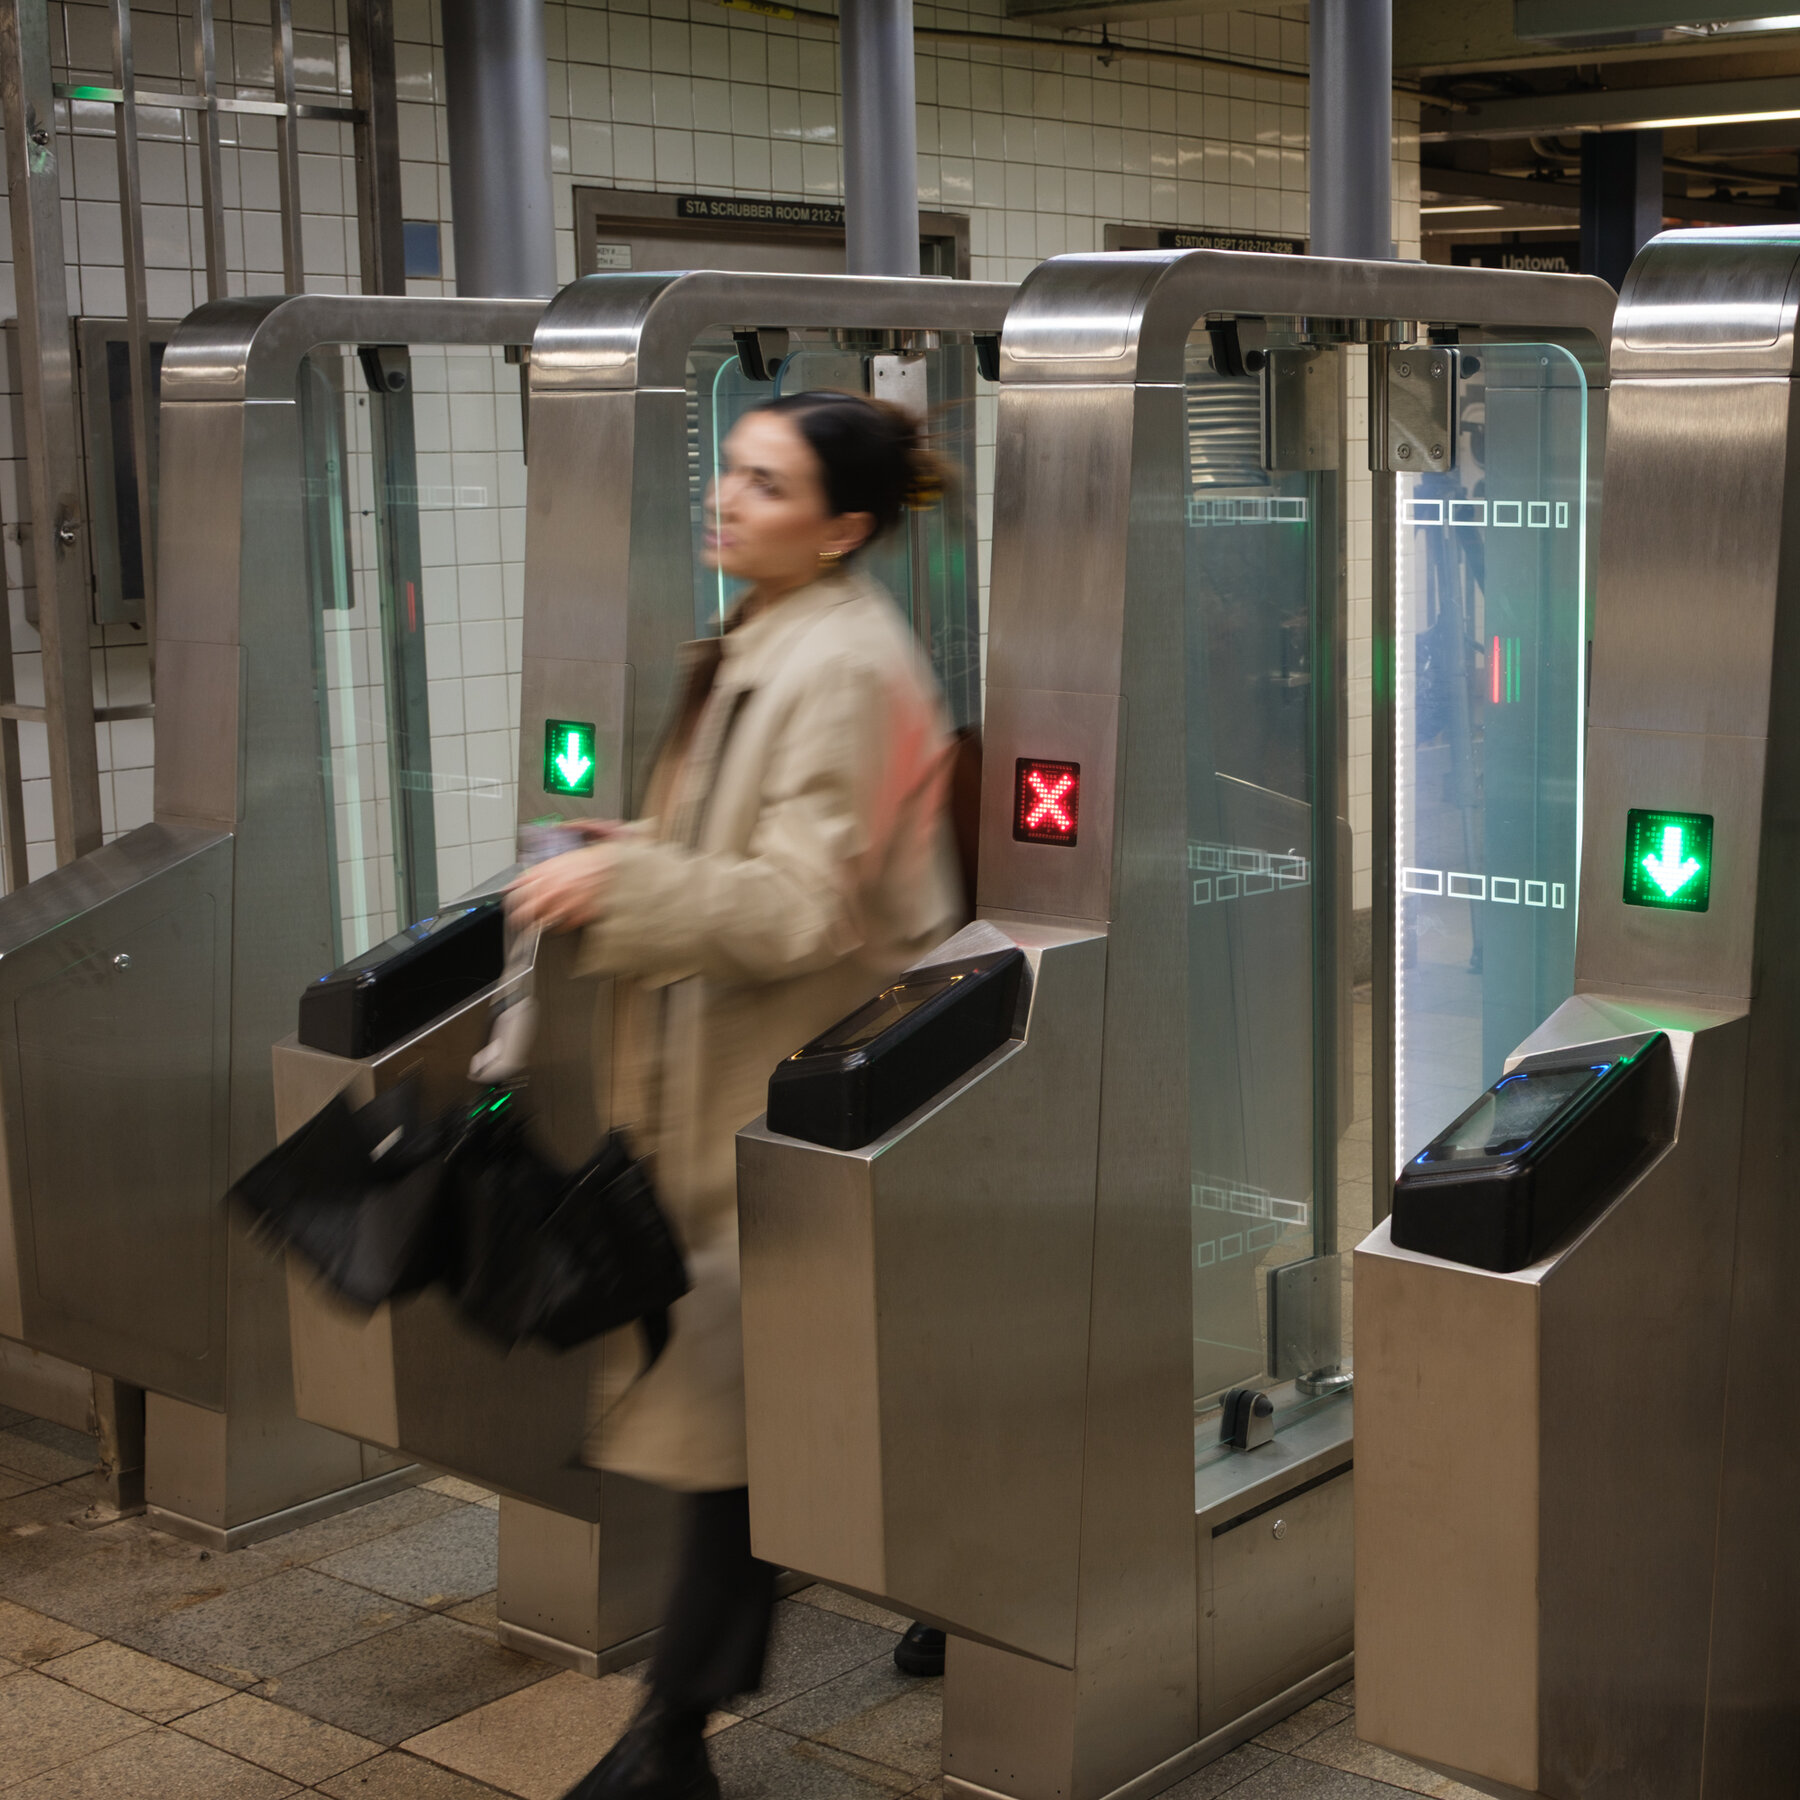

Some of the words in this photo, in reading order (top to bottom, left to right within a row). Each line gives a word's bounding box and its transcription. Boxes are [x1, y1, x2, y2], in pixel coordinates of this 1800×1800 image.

[686, 200, 708, 214] STA
[710, 202, 773, 219] SCRUBBER
[776, 206, 810, 221] ROOM
[812, 209, 846, 223] 212-71
[1175, 234, 1212, 248] STATION
[1214, 238, 1237, 250] DEPT
[1502, 253, 1570, 273] Uptown,
